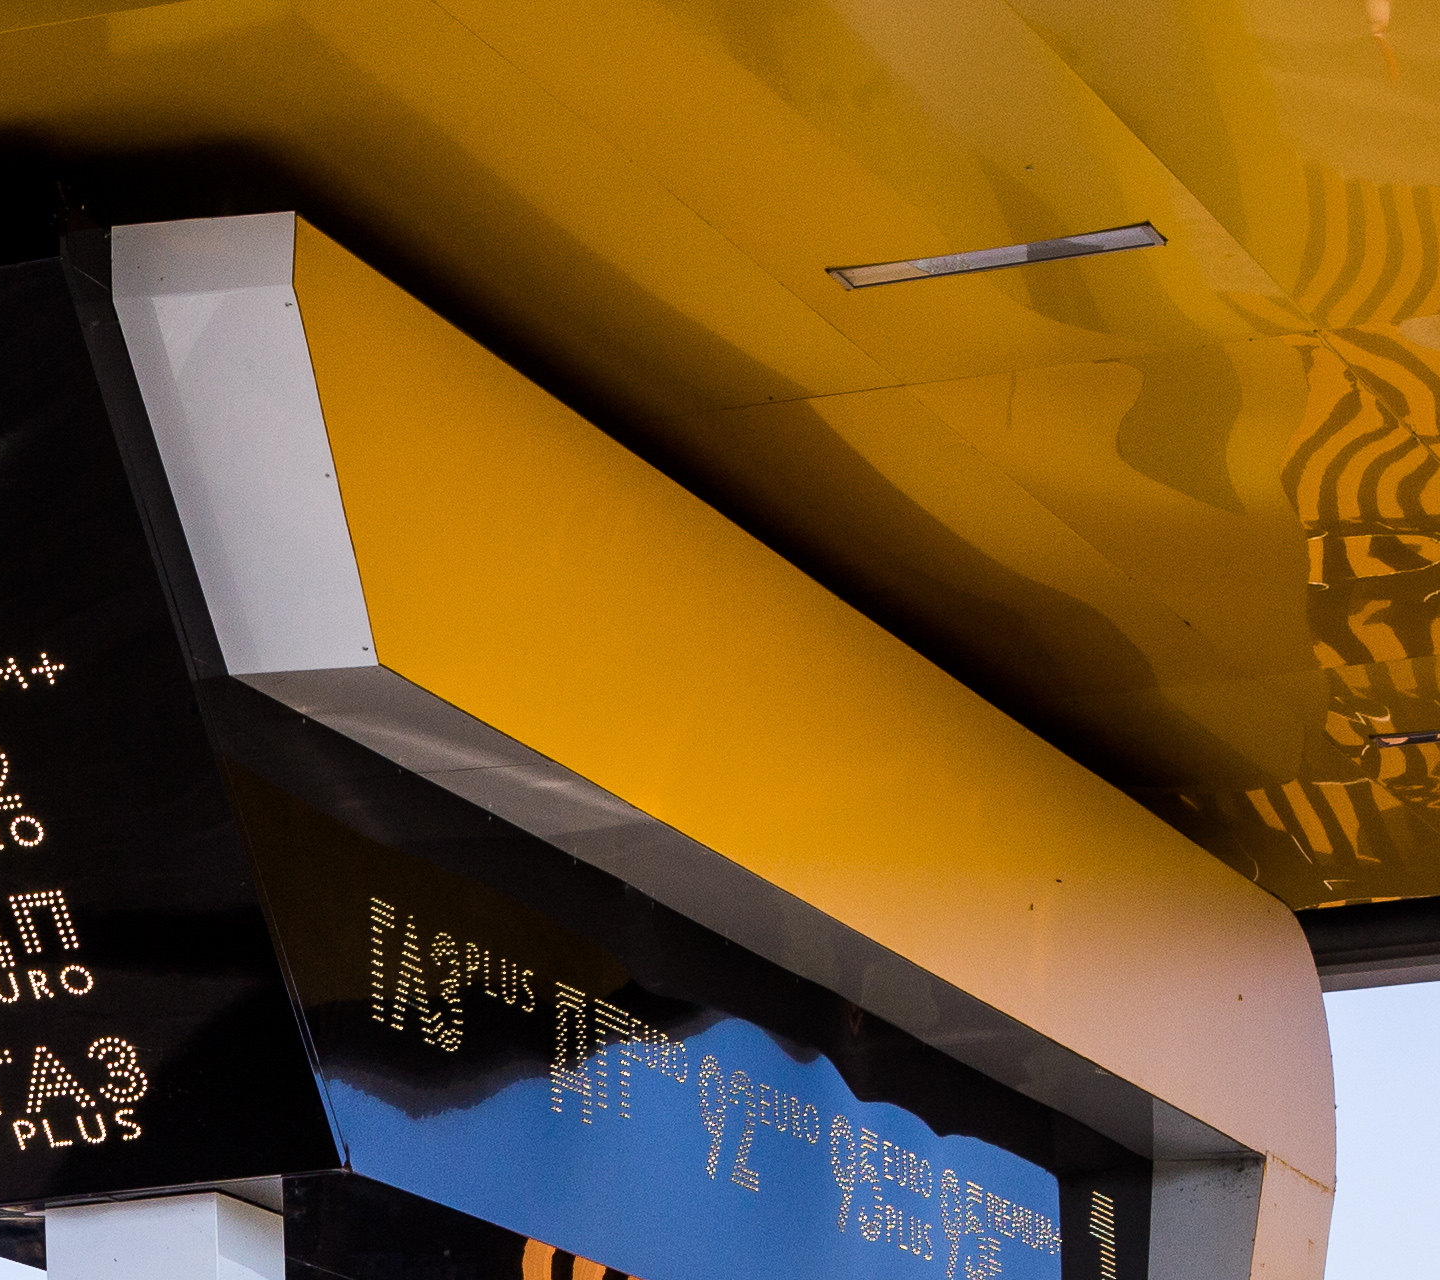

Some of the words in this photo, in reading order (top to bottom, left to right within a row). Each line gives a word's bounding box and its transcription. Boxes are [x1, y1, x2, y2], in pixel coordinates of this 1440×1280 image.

[465, 941, 536, 1014] PLUS
[630, 1017, 689, 1085] EURO
[759, 1083, 820, 1145] EURO
[12, 1108, 143, 1151] PLUS
[884, 1203, 934, 1262] PLUS
